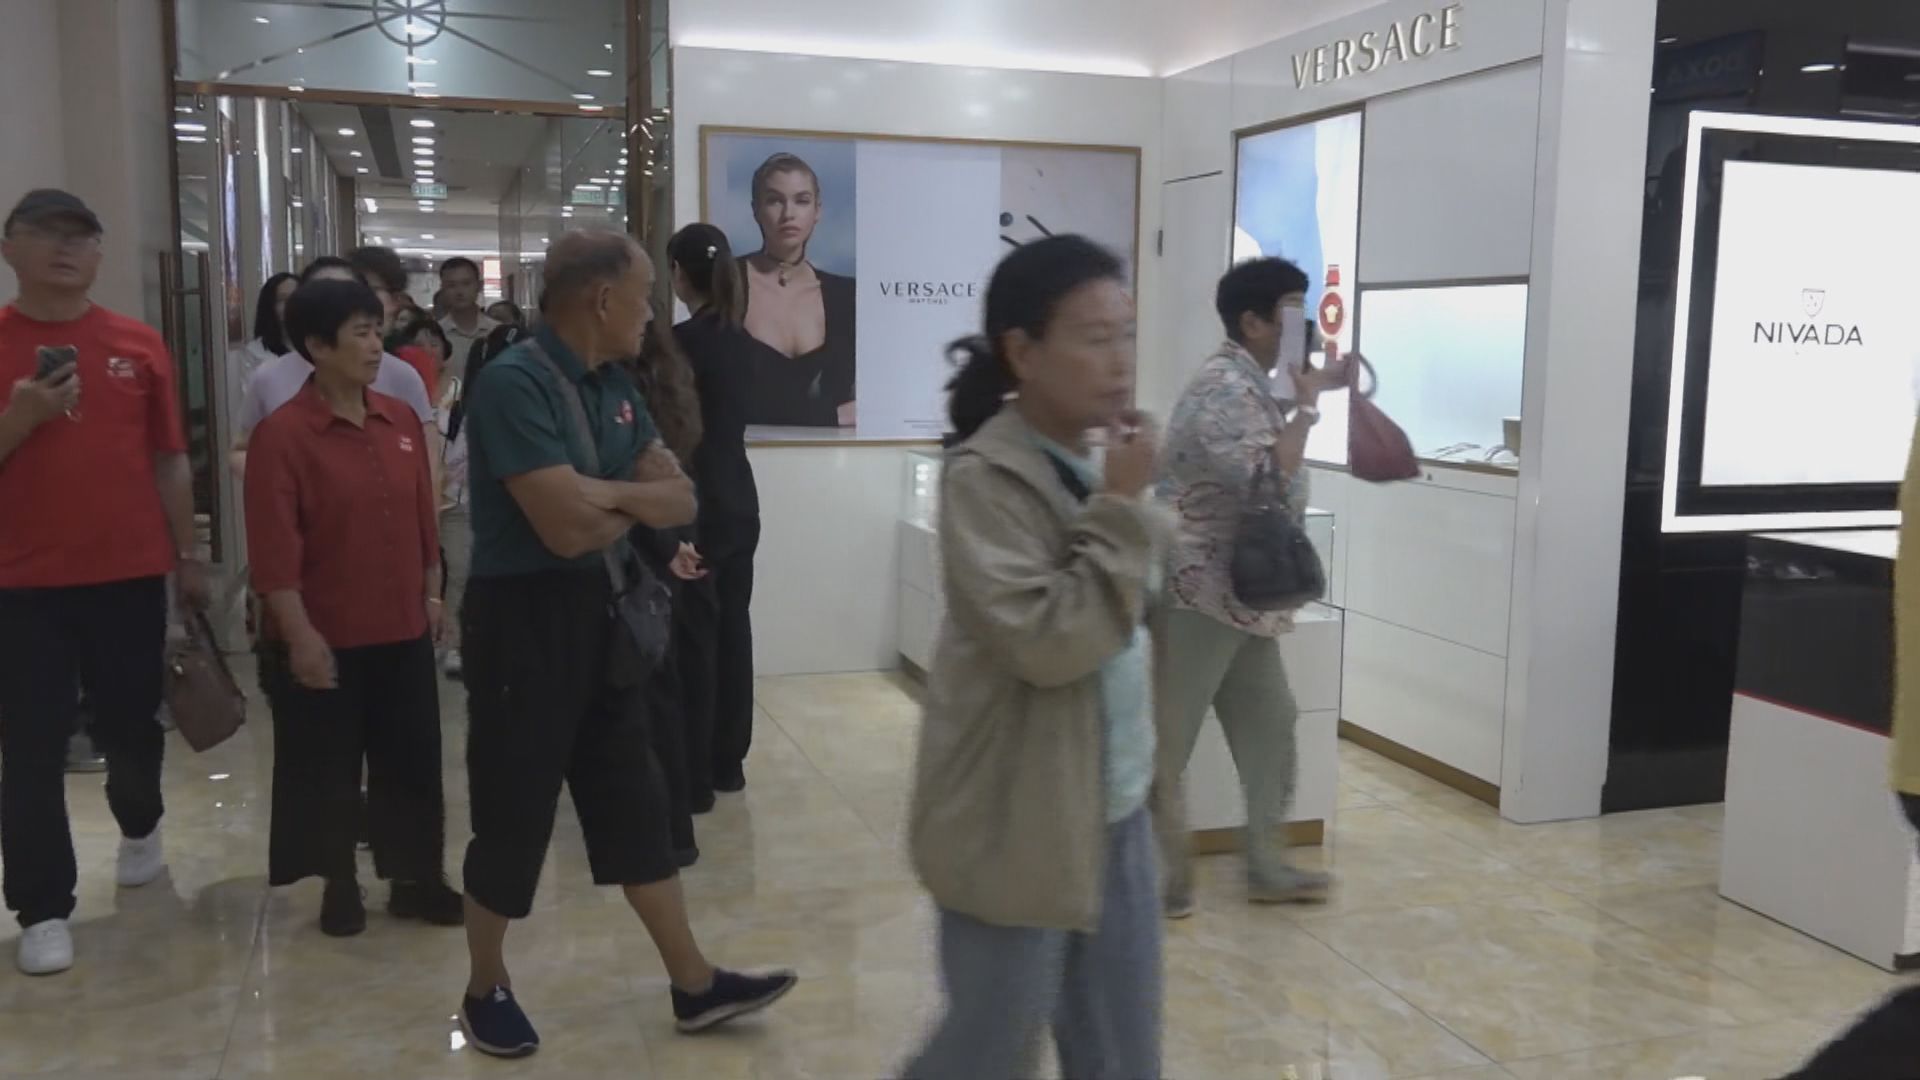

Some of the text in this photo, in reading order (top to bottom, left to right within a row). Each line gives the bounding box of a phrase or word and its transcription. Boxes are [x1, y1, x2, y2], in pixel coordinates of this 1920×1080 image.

[1292, 3, 1463, 90] VERSACE
[880, 282, 977, 297] VERSACE
[1753, 321, 1863, 346] NIVADA
